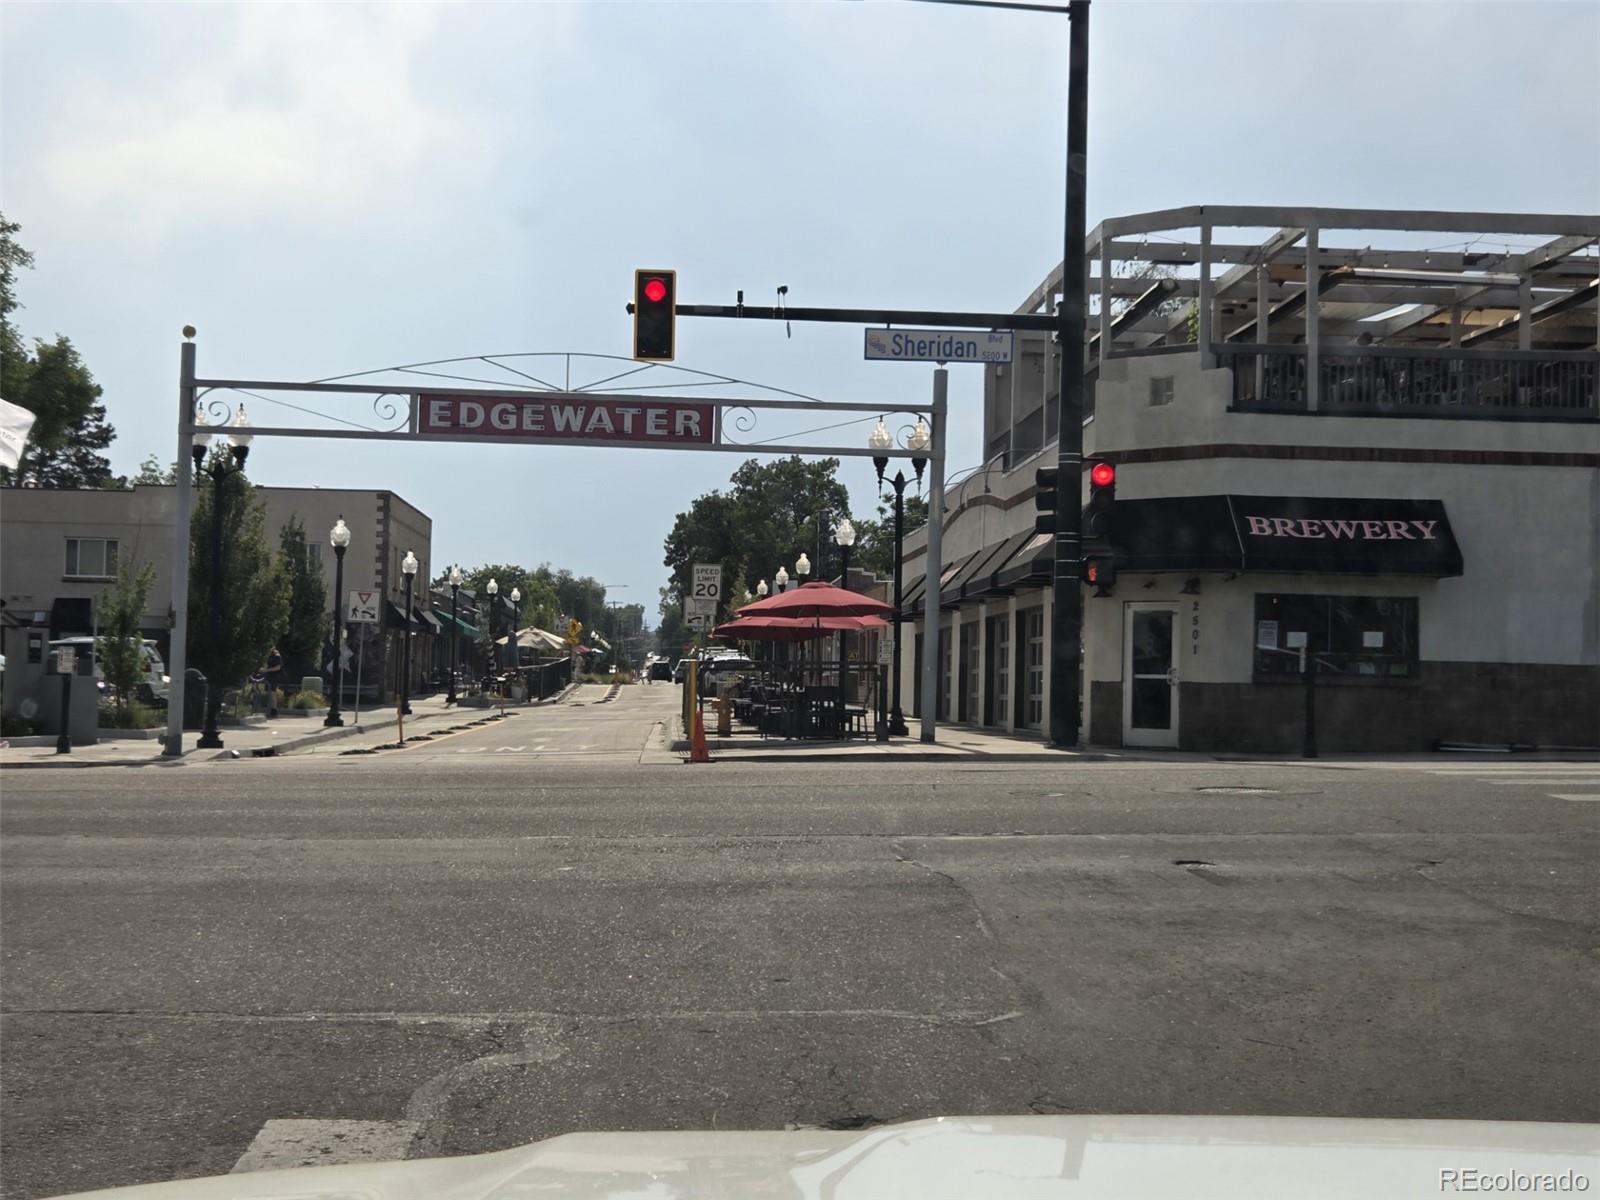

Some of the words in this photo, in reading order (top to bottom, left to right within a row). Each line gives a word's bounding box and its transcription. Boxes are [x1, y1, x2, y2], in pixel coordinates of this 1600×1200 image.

[891, 333, 977, 359] Sheridan
[428, 400, 702, 436] EDGEWATER
[1245, 516, 1440, 541] BREWERY
[695, 583, 718, 597] 20
[1191, 600, 1200, 656] 2501
